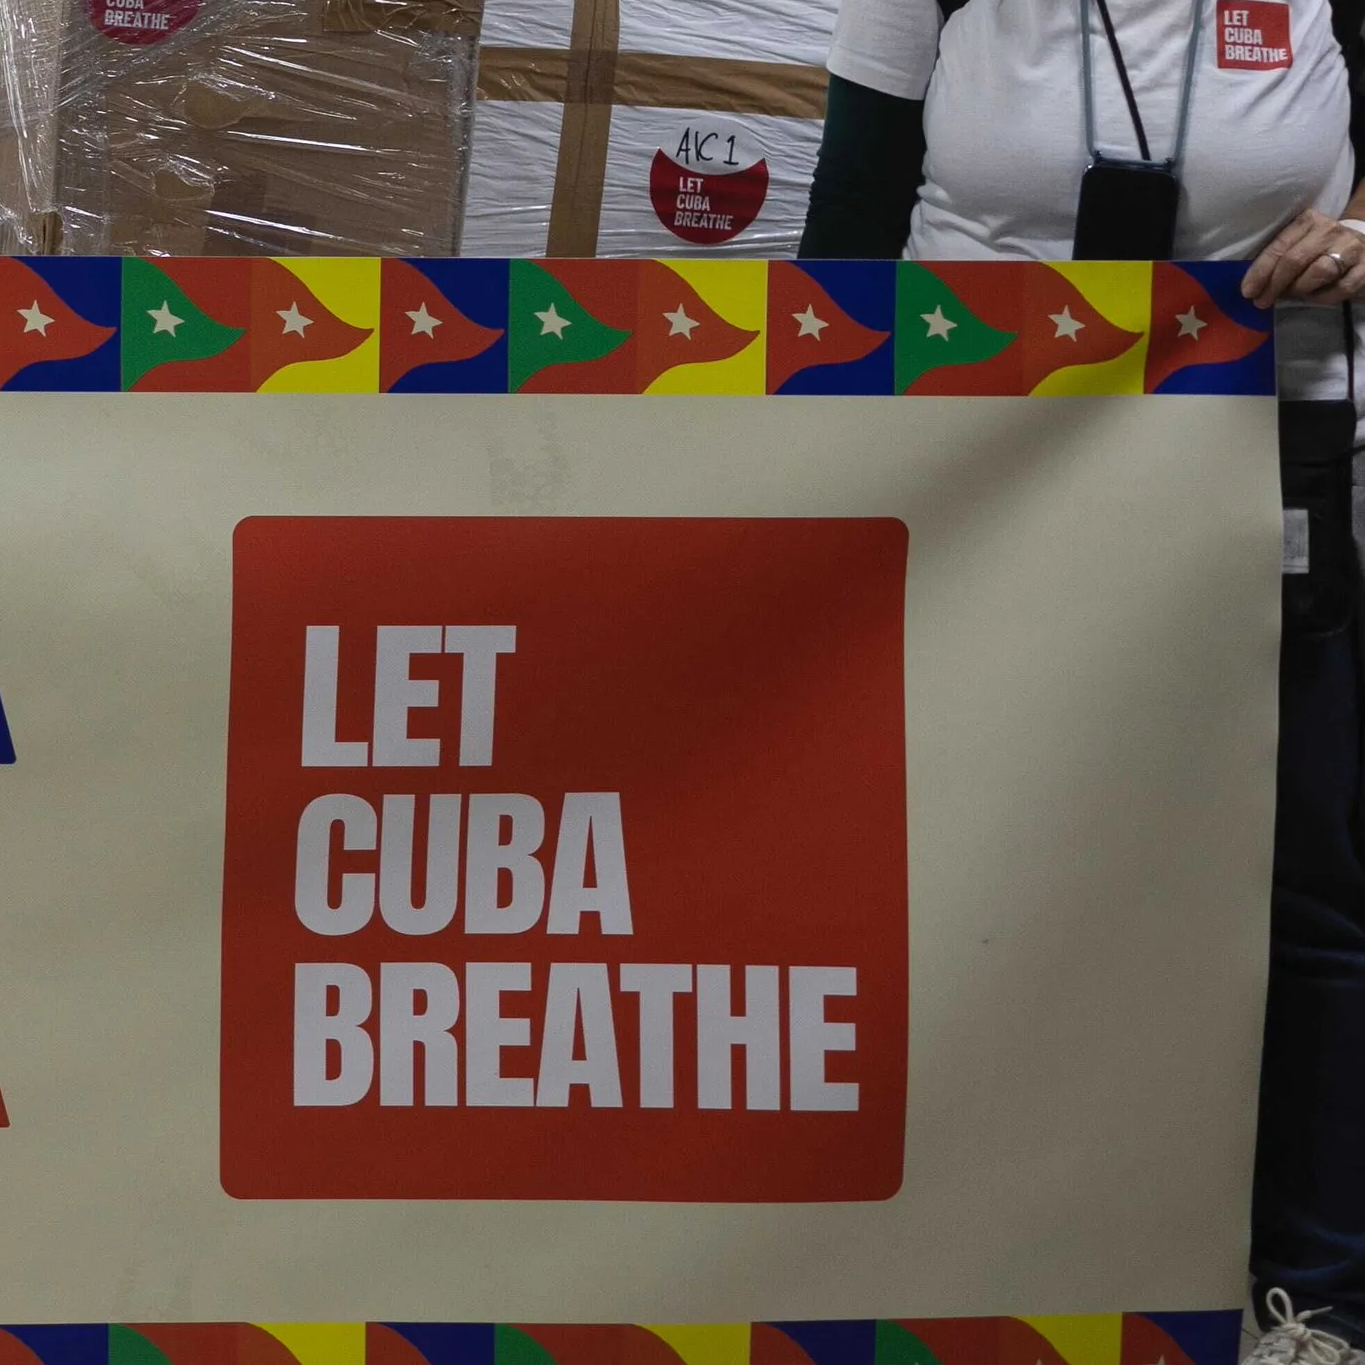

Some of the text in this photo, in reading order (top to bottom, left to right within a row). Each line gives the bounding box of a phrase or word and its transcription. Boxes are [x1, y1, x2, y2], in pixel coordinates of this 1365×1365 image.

[104, 9, 170, 30] BREATHE
[1223, 9, 1249, 26] LET
[1224, 27, 1263, 45] CUBA
[1225, 44, 1289, 63] BREATHE
[678, 176, 704, 193] LET
[676, 194, 711, 212] CUBA
[674, 211, 734, 230] BREATHE
[301, 625, 517, 767] LET
[294, 791, 635, 936] CUBA
[293, 961, 860, 1112] BREATHE
